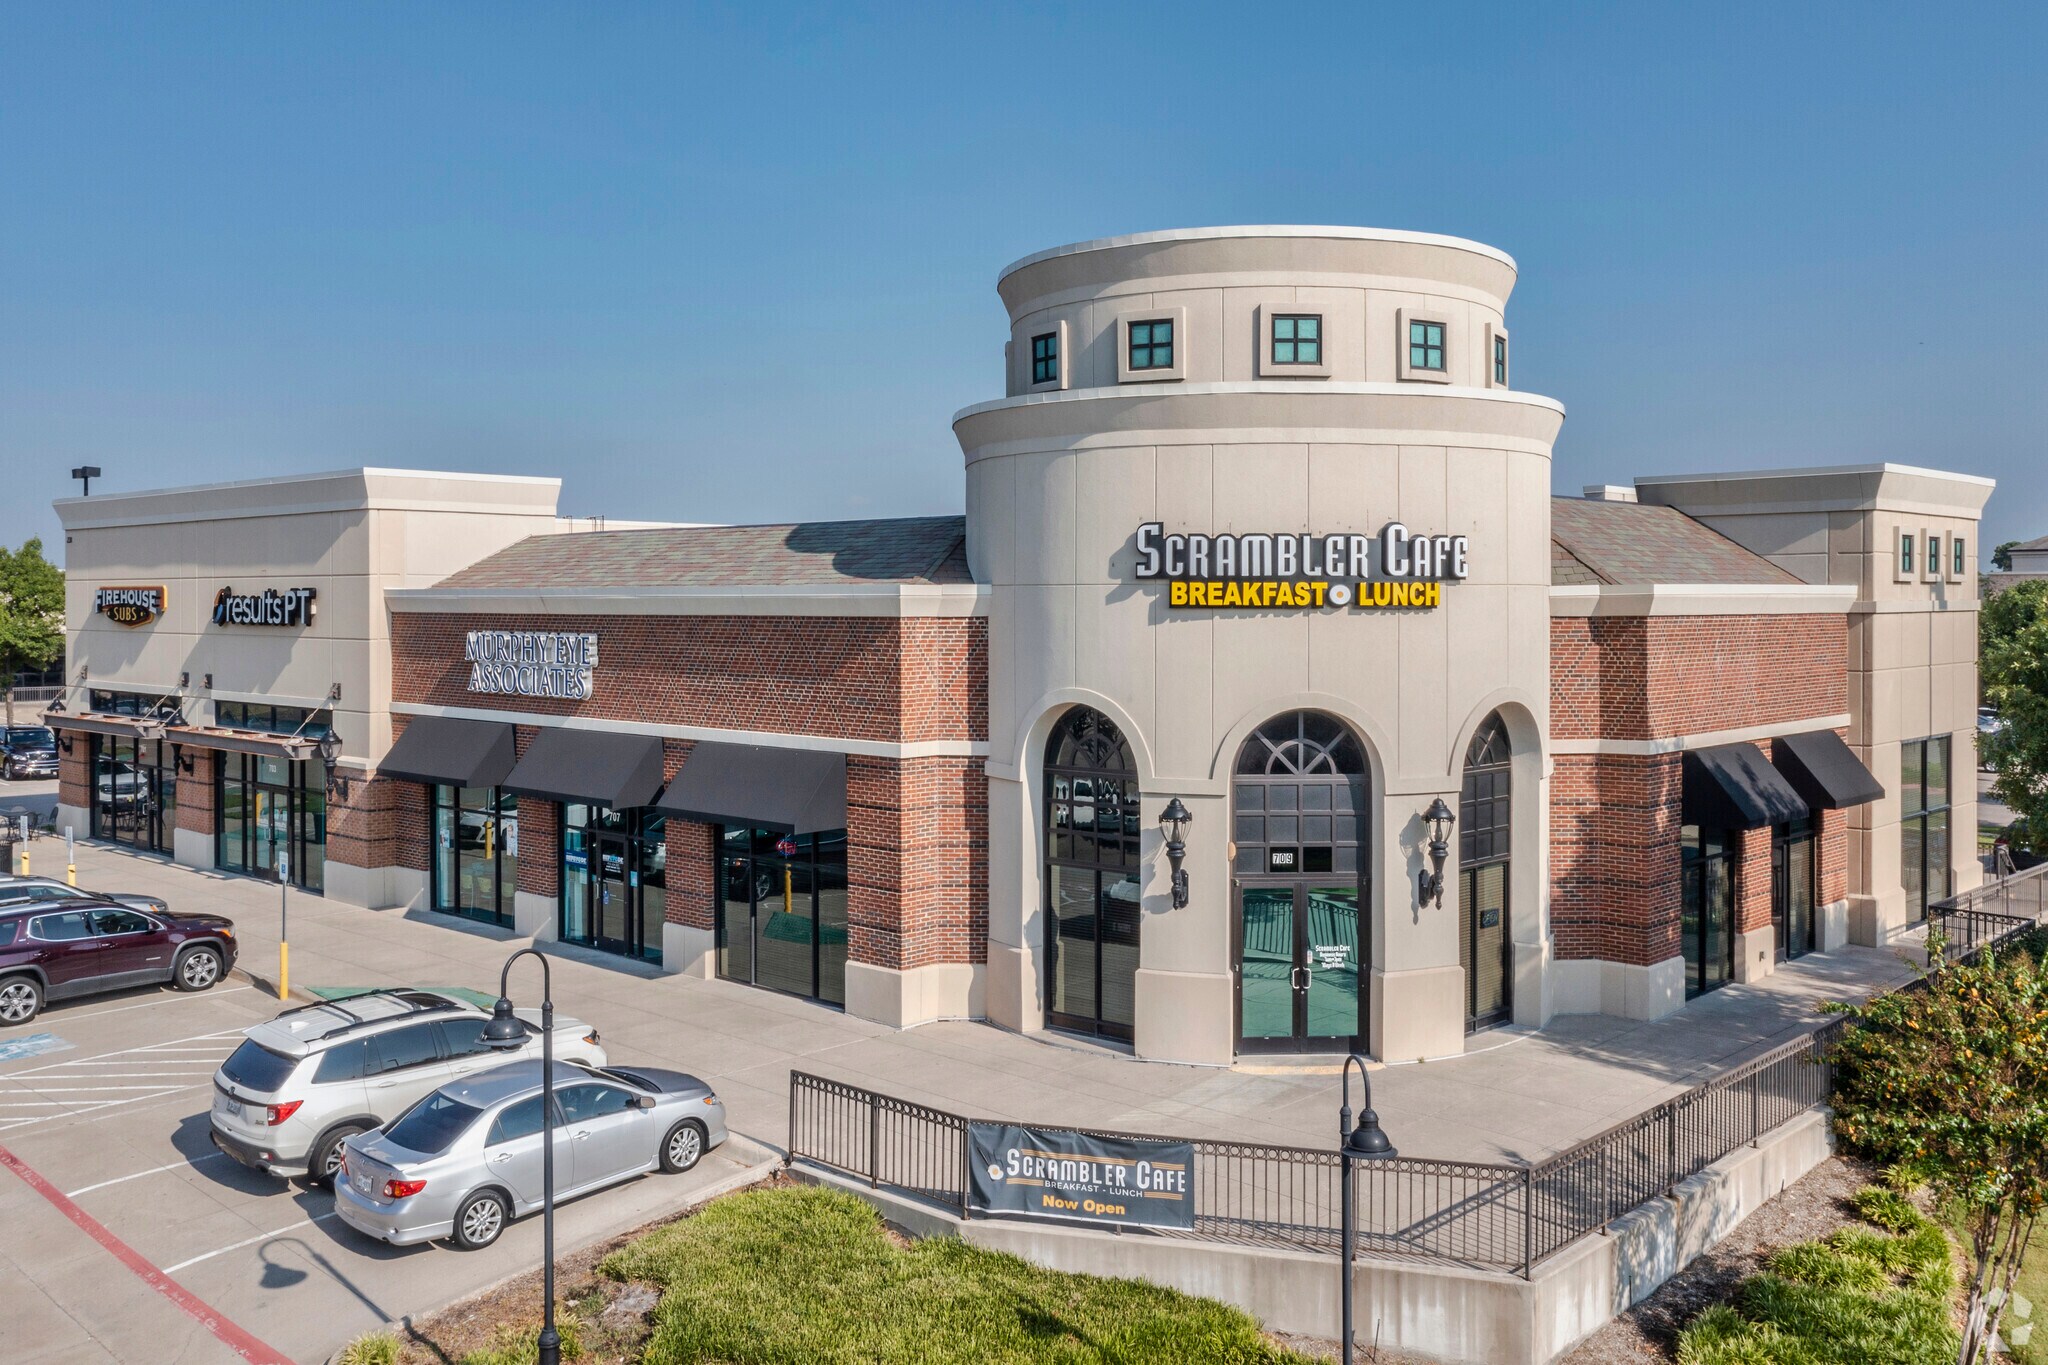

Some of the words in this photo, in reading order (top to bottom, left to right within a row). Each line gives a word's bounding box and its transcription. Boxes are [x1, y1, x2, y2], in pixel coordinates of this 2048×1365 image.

[1137, 523, 1368, 578] SCRAMBLER
[1386, 522, 1469, 578] CAFE
[95, 589, 157, 614] FIREHOUSE
[1169, 581, 1328, 606] BREAKFAST
[1358, 582, 1440, 606] LUNCH
[113, 606, 138, 622] SUBS
[465, 631, 549, 663] MURPHY
[554, 634, 593, 666] EYE
[468, 662, 586, 699] ASSOCIATES
[609, 812, 621, 822] 707
[1273, 853, 1293, 864] 709
[1006, 1148, 1126, 1187] SCRAMBLER
[1136, 1160, 1186, 1192] CAFE
[1044, 1179, 1099, 1193] BREAKFAST
[1109, 1187, 1144, 1198] LUNCH
[1042, 1194, 1079, 1210] Now
[1083, 1199, 1126, 1216] Open
